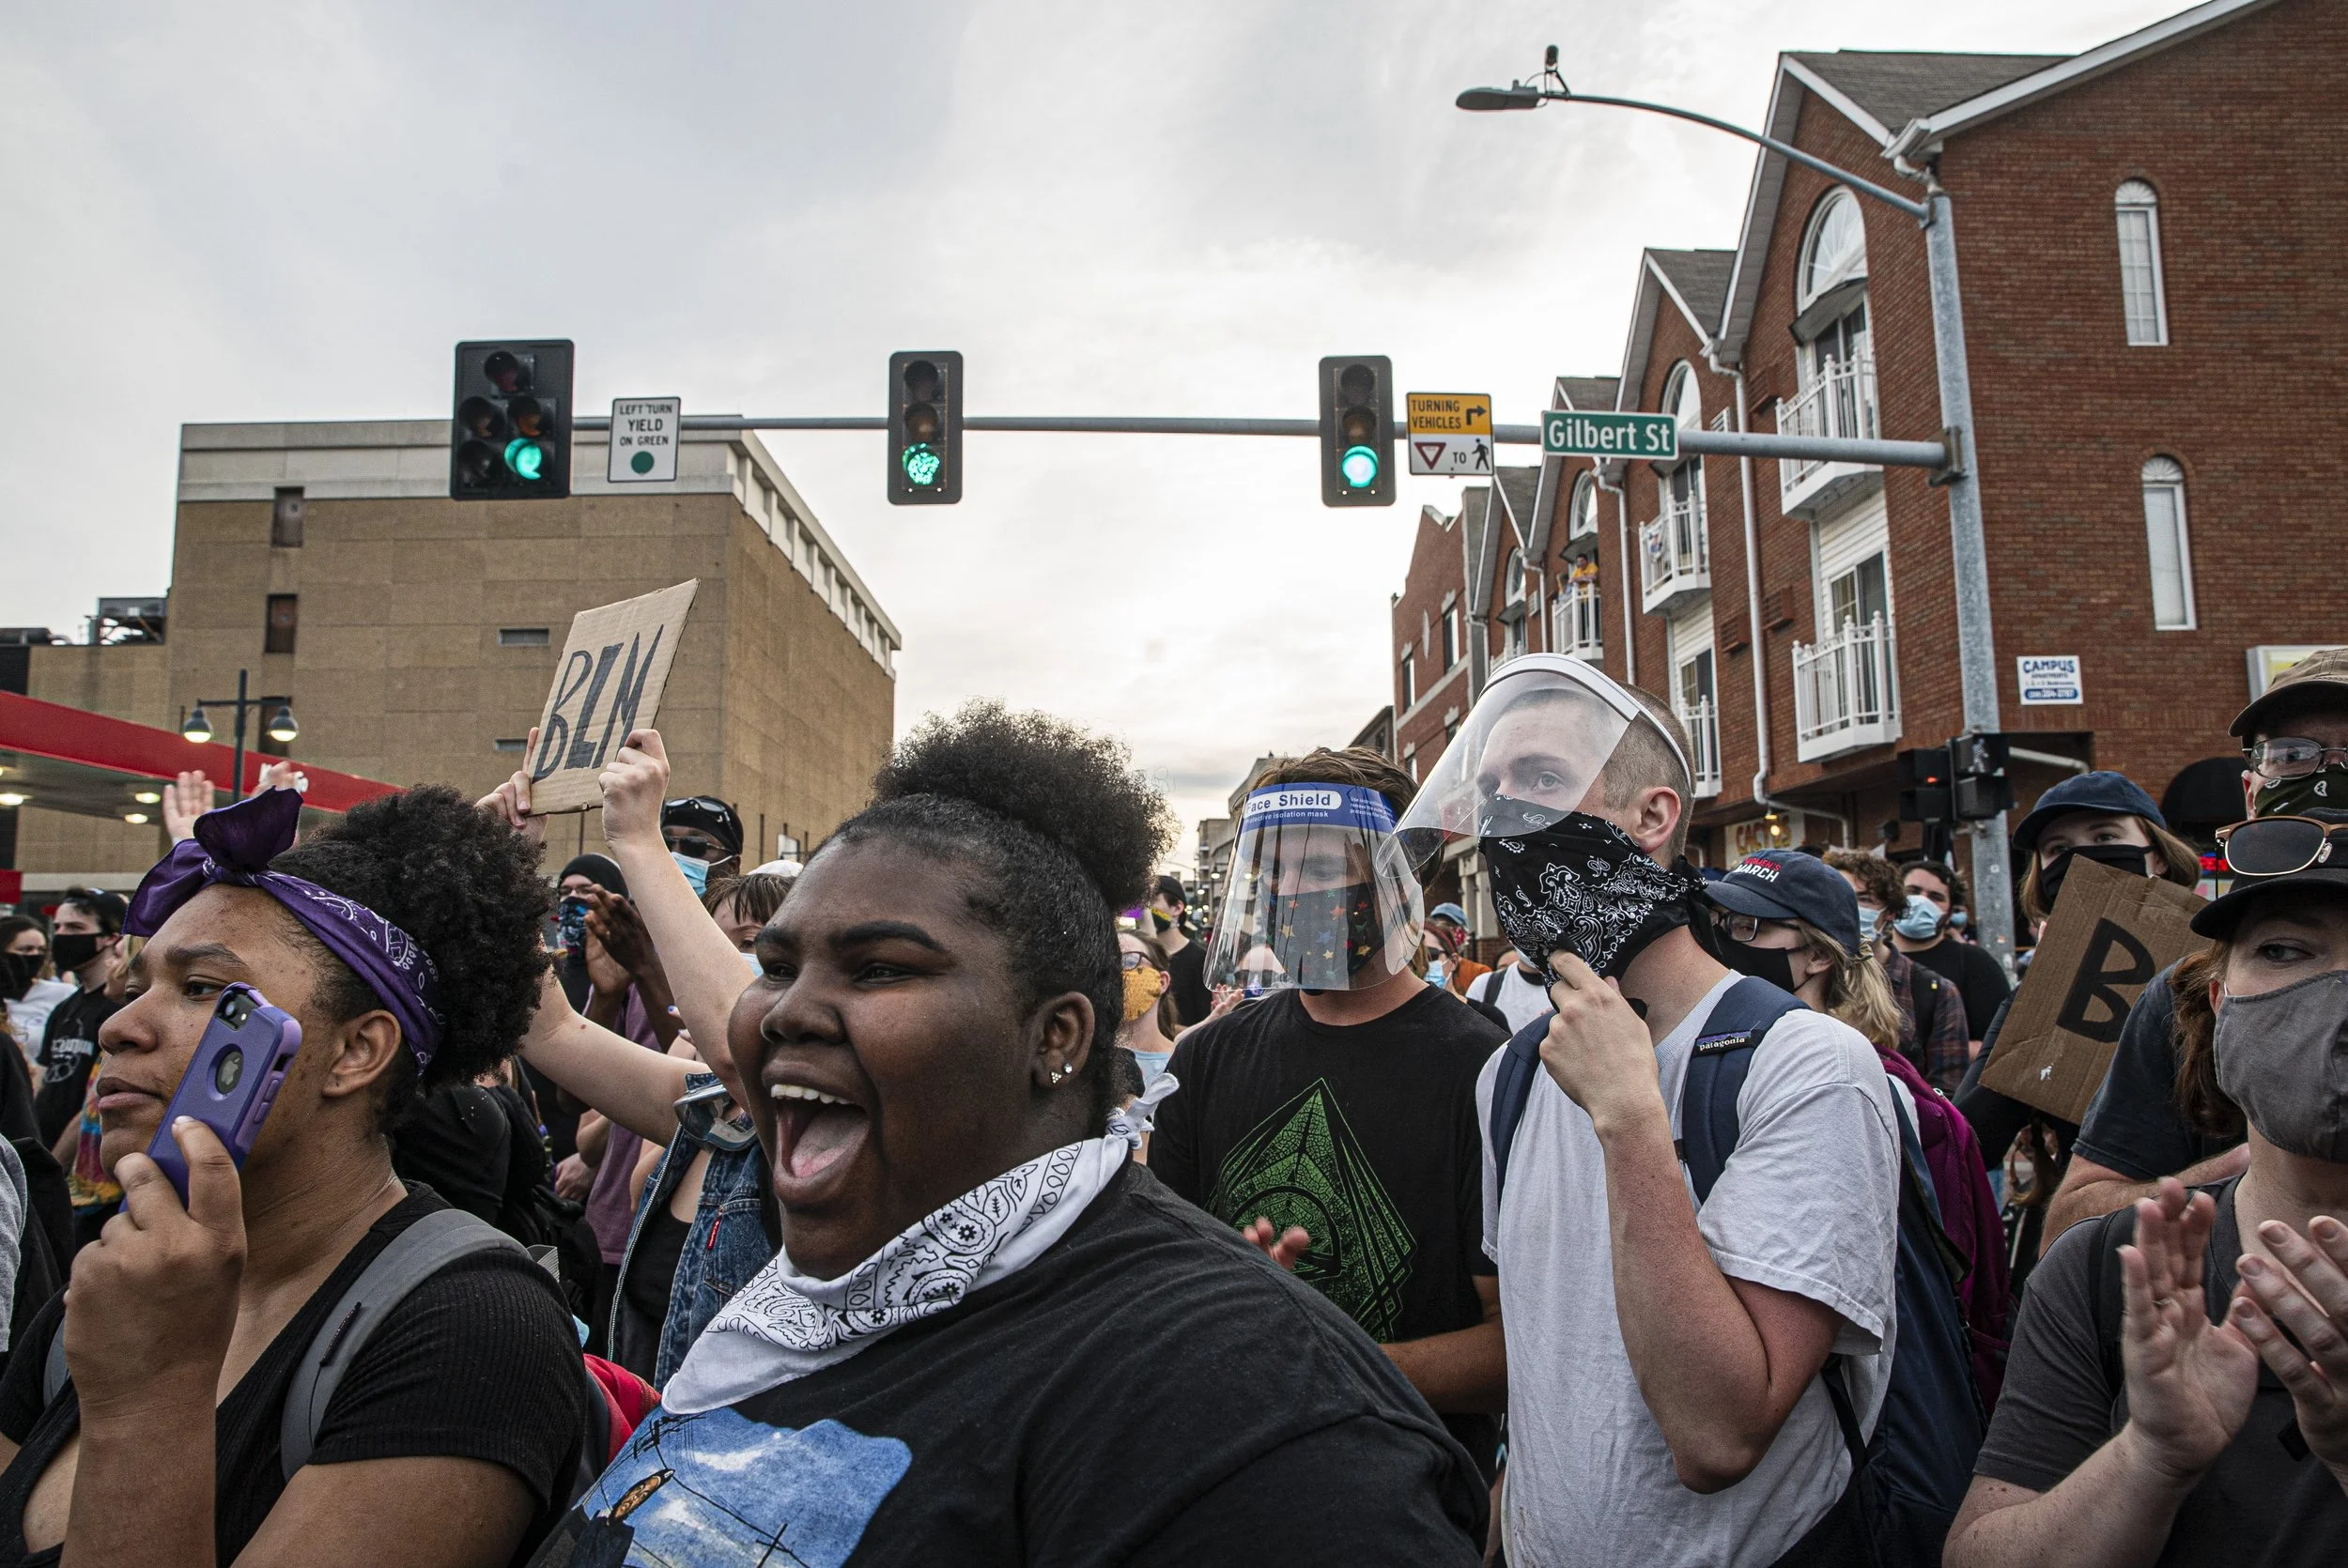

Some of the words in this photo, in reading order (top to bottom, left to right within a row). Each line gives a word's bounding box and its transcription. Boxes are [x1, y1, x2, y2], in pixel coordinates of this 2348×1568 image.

[620, 404, 642, 415] LEFT
[645, 403, 672, 414] TURN
[1412, 399, 1460, 413] TURNING
[628, 418, 663, 432] YIELD
[1413, 416, 1461, 429] VEHICLES
[620, 437, 632, 447] ON
[638, 436, 669, 446] GREEN
[1550, 418, 1637, 450] Gilbert
[1645, 423, 1670, 452] St
[1453, 452, 1467, 464] TO
[2023, 660, 2075, 673] CAMPUS
[532, 624, 664, 783] BLM
[1279, 793, 1331, 807] Shield
[1274, 810, 1305, 819] isolation
[1699, 1037, 1746, 1051] patagonia
